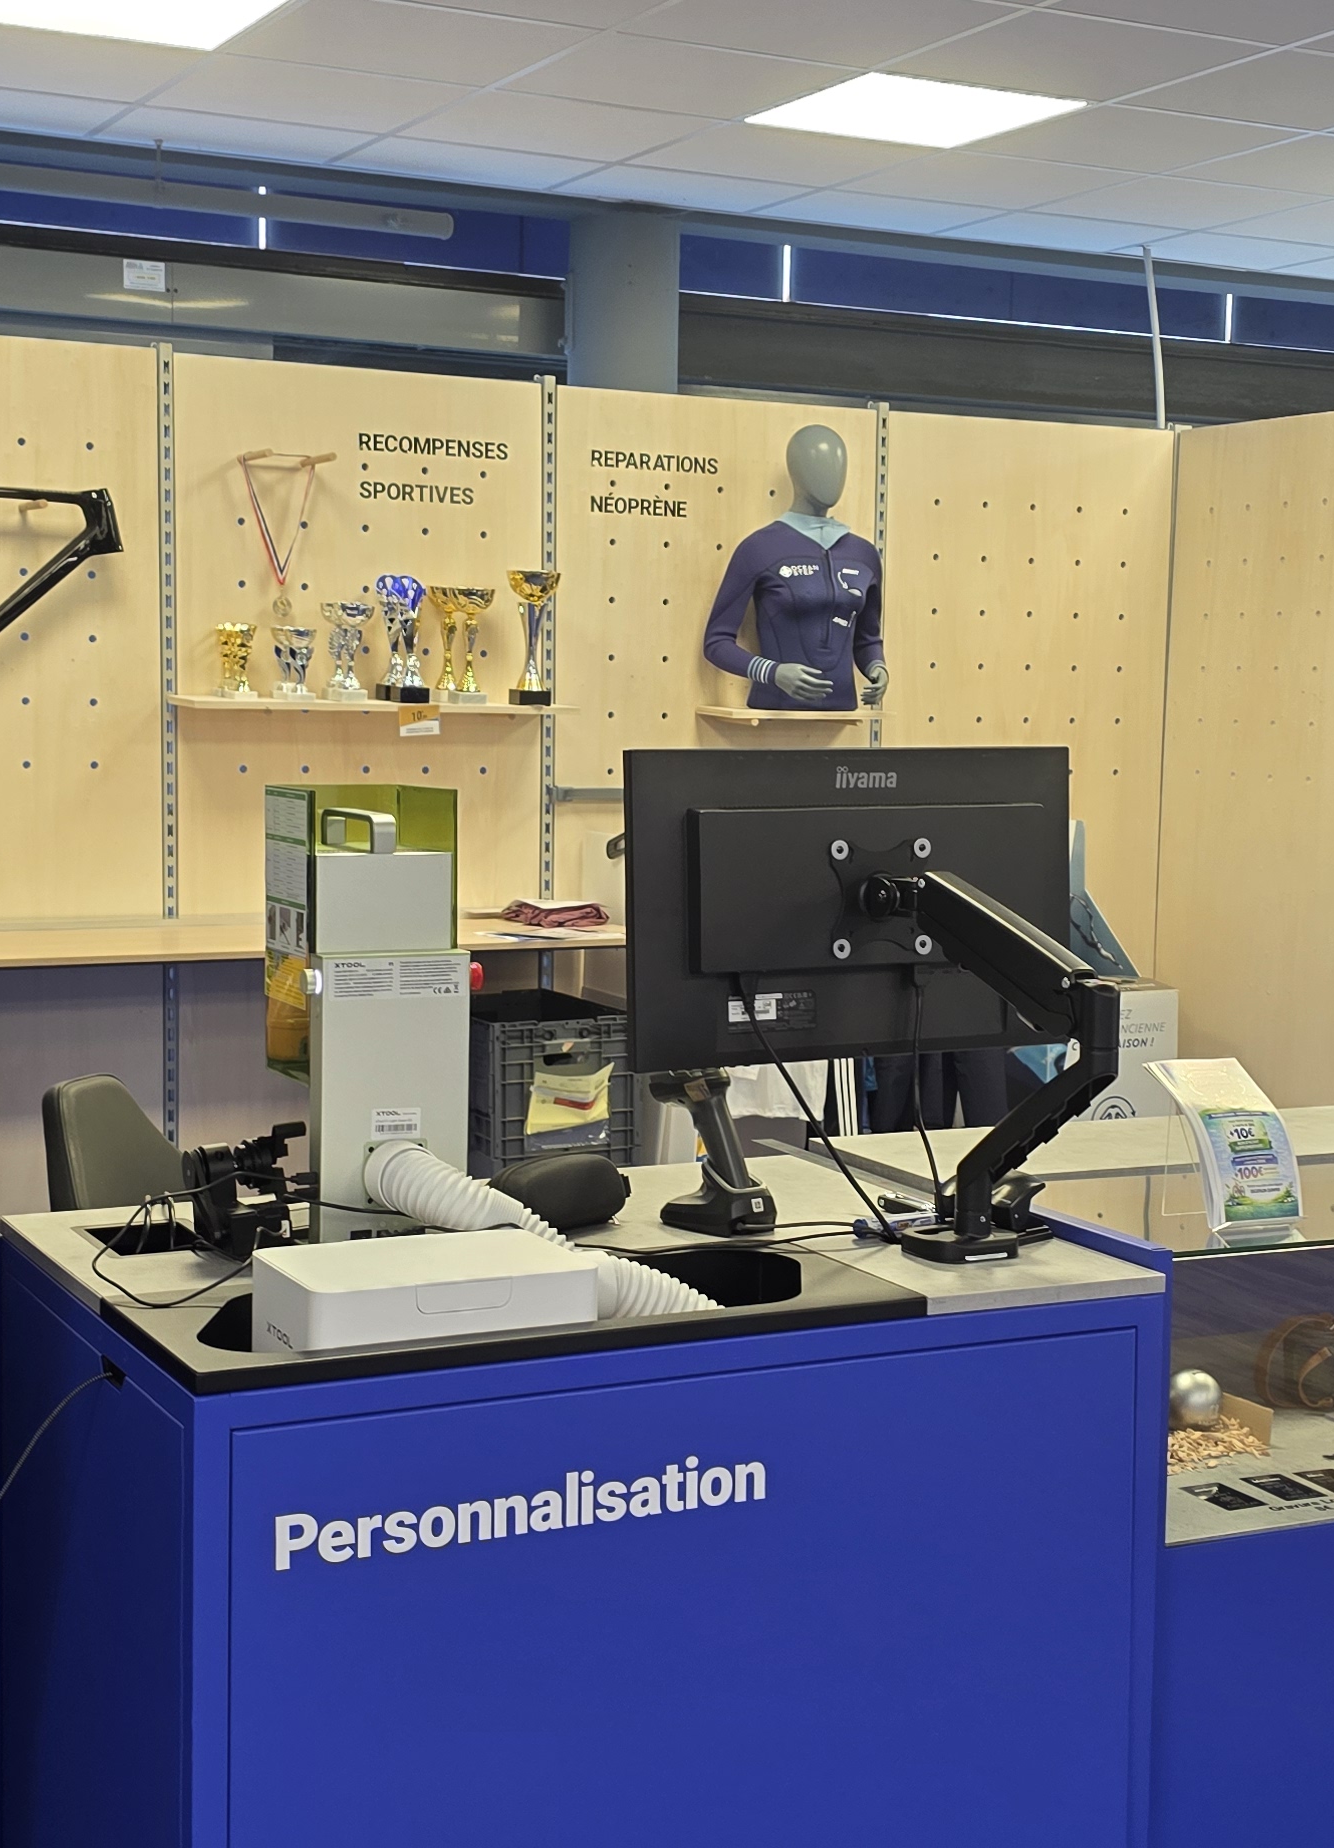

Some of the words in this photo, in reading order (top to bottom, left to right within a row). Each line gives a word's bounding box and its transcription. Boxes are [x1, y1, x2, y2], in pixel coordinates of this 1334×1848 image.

[357, 433, 509, 461] RECOMPENSES
[590, 449, 719, 475] REPARATIONS
[358, 480, 475, 506] SPORTIVES
[589, 493, 688, 519] NÉOPRÈNE
[835, 766, 898, 789] iiyama
[273, 1455, 767, 1571] Personnalisation
